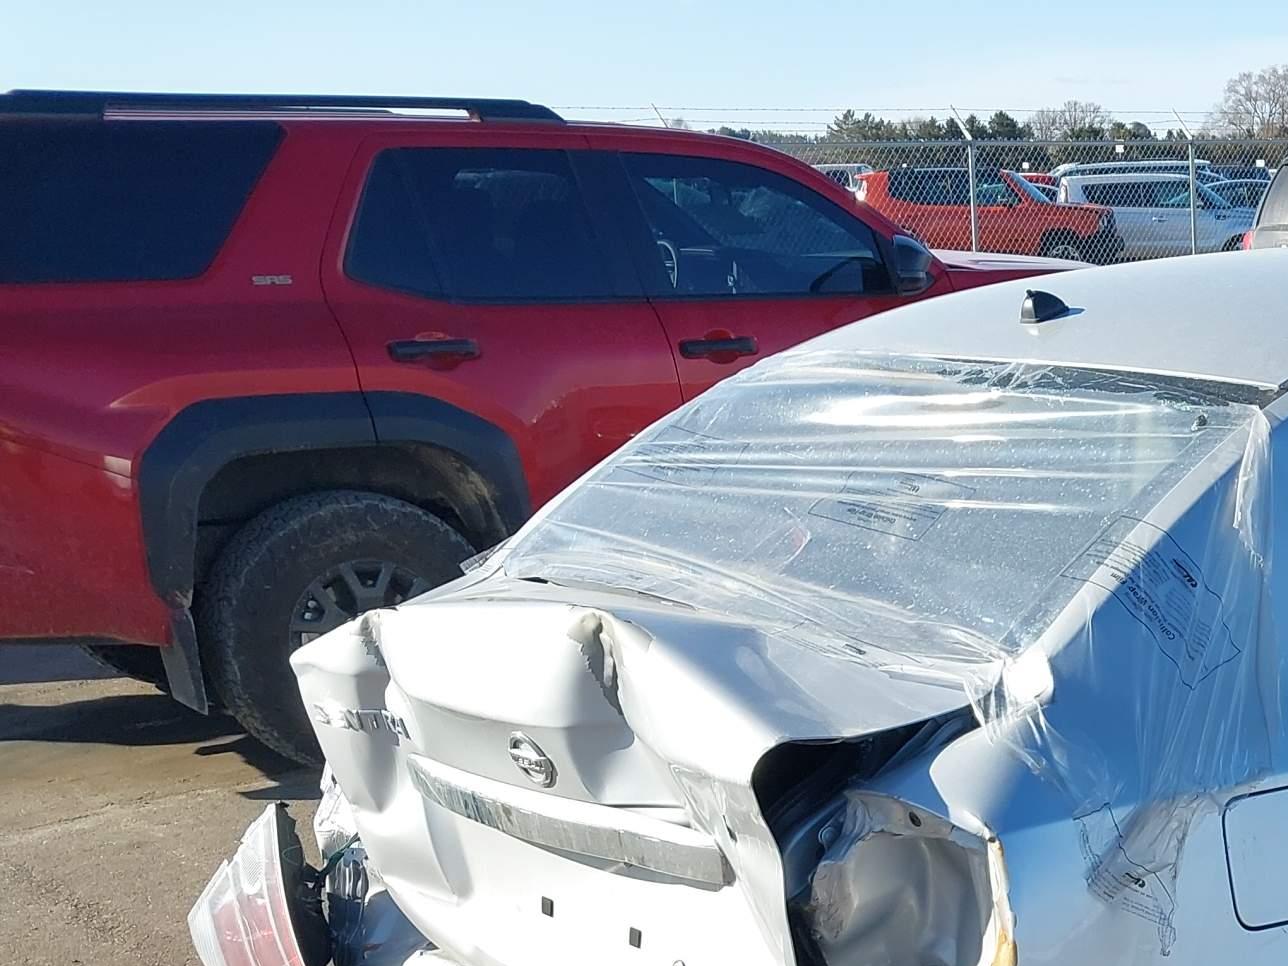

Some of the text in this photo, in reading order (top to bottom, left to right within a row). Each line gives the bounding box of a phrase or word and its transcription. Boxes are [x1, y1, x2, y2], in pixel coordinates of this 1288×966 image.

[1110, 572, 1176, 641] Collision Wrap Film
